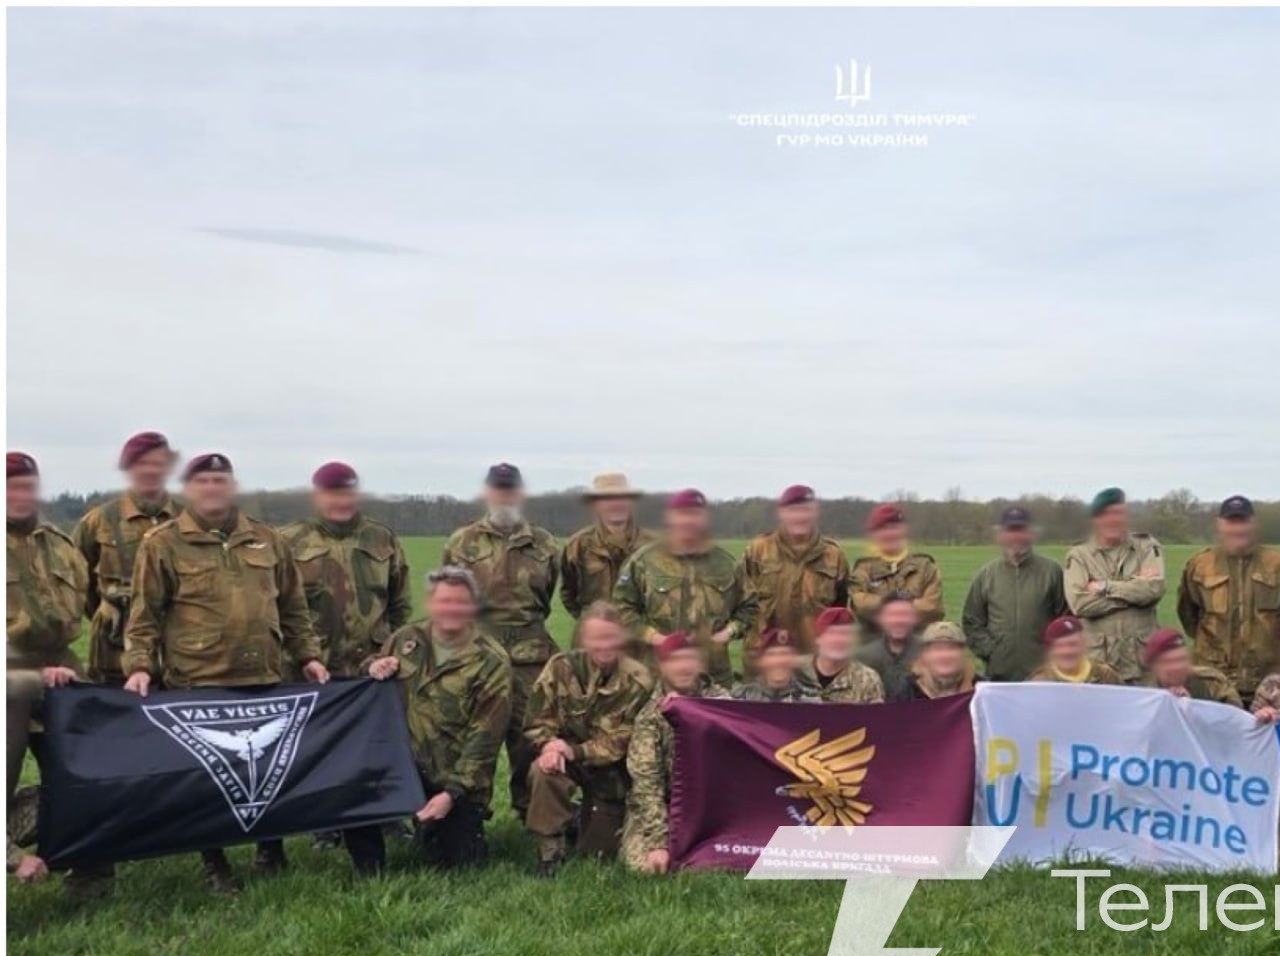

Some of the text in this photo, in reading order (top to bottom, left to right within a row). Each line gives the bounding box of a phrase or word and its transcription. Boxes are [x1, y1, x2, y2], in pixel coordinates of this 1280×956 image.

[180, 707, 222, 721] VAE
[1070, 743, 1270, 806] Promote
[1065, 793, 1247, 854] Ukraine
